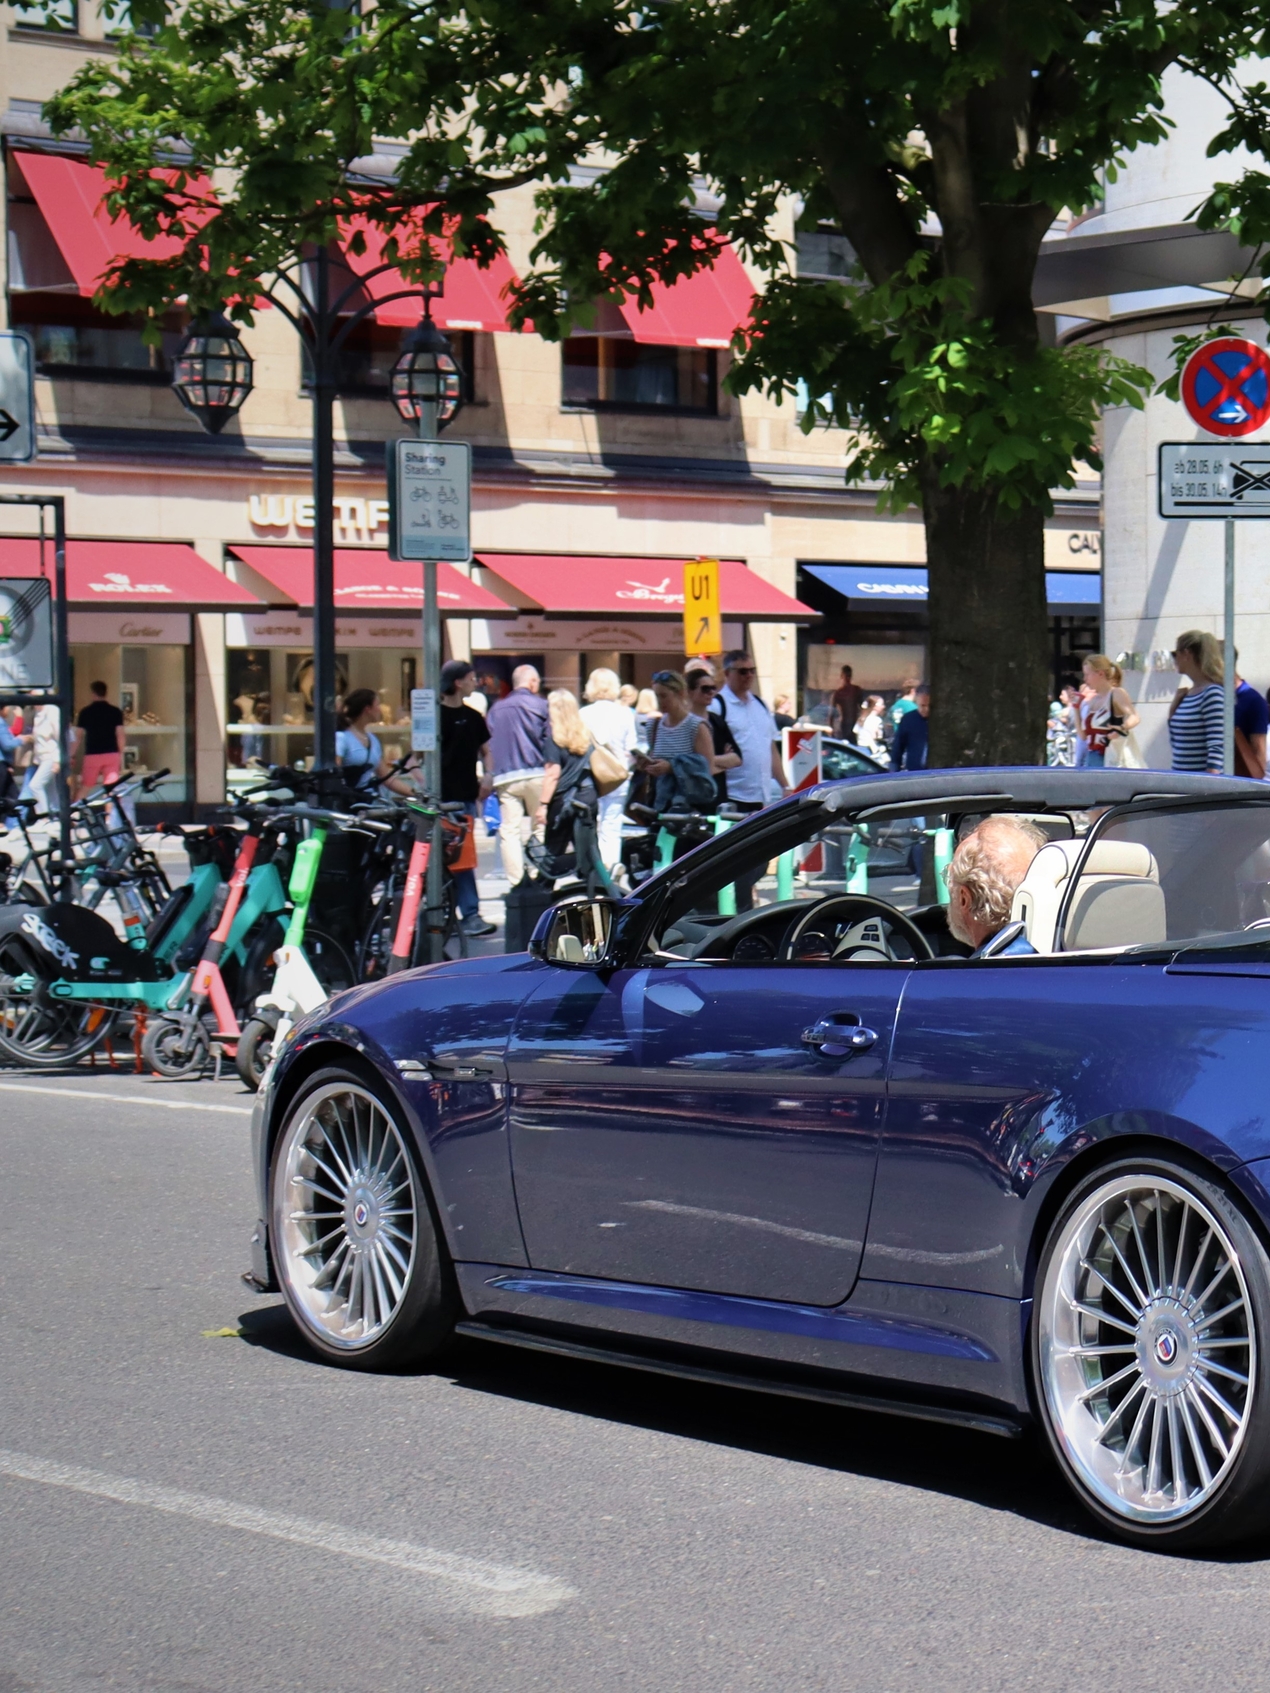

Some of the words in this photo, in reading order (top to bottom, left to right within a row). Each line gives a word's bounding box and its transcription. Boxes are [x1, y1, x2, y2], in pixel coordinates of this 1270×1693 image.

[405, 452, 446, 466] Sharing
[405, 464, 441, 475] Station
[1174, 460, 1185, 474] ab
[1171, 483, 1184, 497] bis
[692, 576, 710, 600] U1
[119, 622, 163, 638] Cartier
